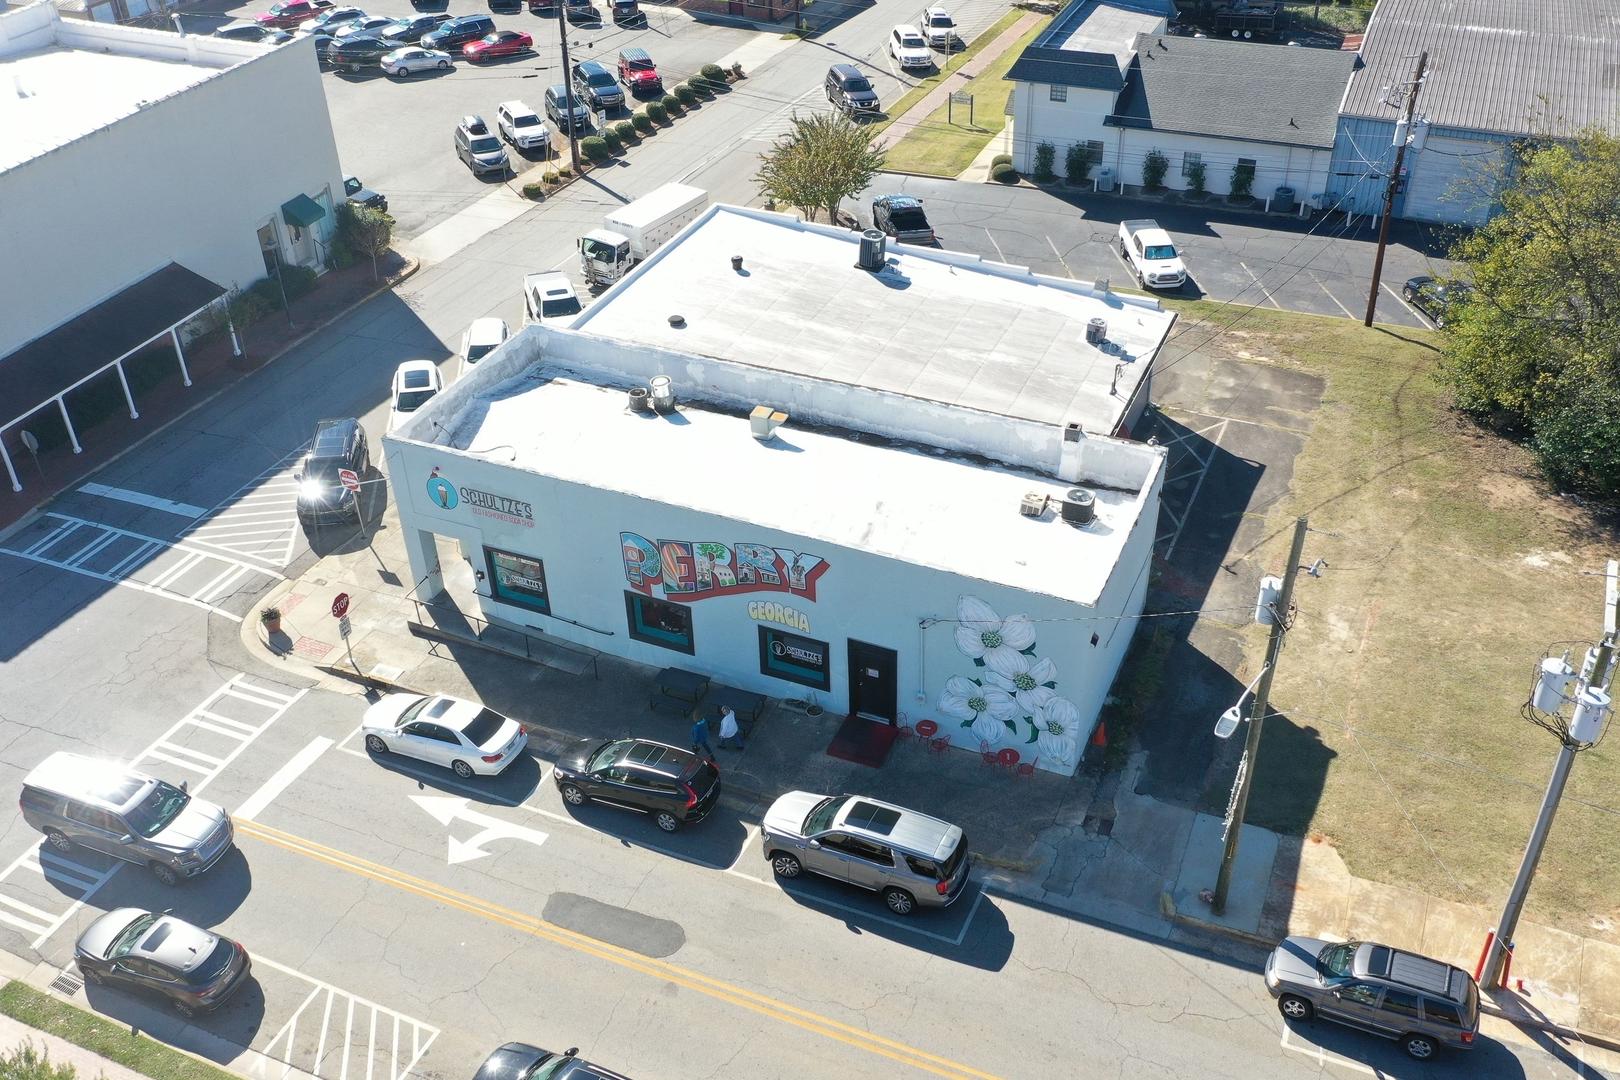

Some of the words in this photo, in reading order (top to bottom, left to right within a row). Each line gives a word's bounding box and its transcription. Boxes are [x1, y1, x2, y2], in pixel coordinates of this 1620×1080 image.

[460, 487, 534, 520] SCHULTZE'S
[620, 531, 830, 603] PERRY
[333, 596, 348, 615] STOP
[748, 600, 811, 634] GEORGIA
